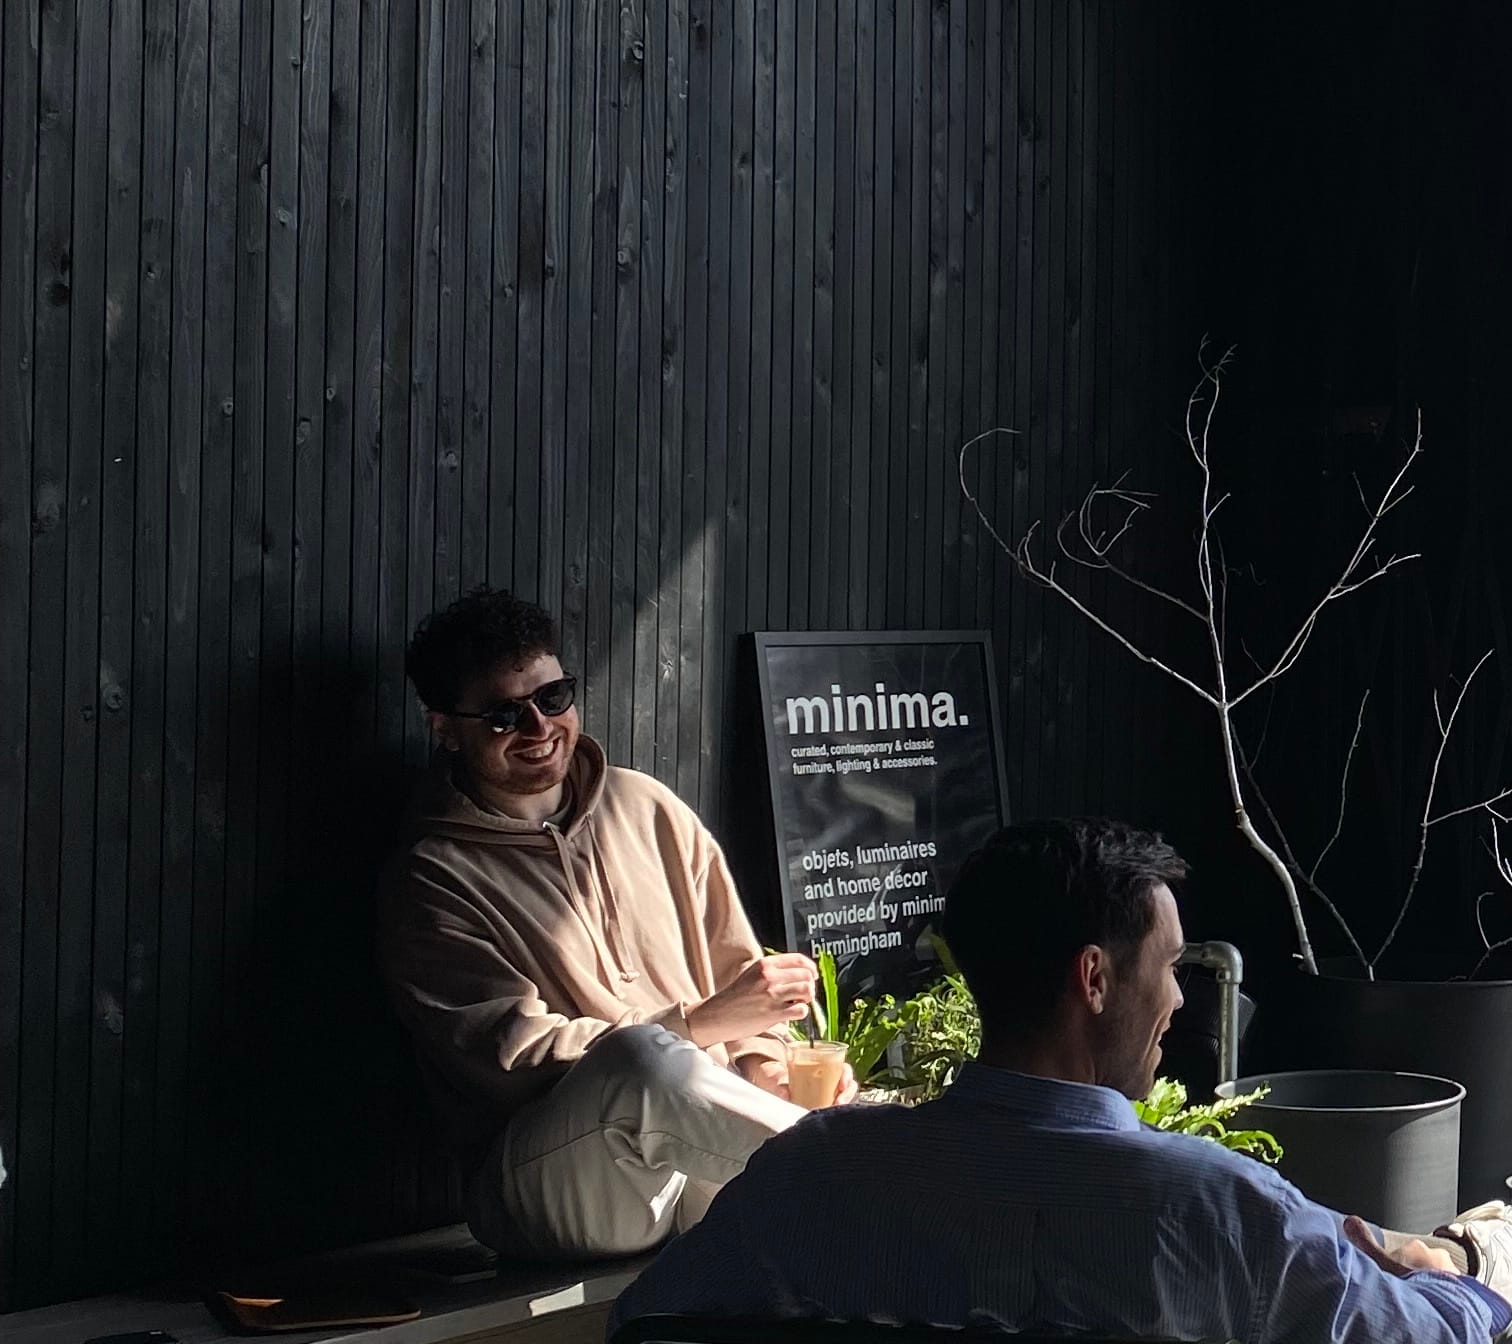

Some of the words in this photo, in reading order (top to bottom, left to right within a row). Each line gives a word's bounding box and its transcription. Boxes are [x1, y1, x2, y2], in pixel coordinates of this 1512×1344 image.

[786, 682, 969, 735] minima.
[791, 744, 830, 757] curated,
[830, 741, 893, 755] contemporary
[894, 739, 902, 751] &
[903, 737, 935, 751] classic
[792, 761, 836, 775] furniture,
[836, 758, 872, 774] lighting
[872, 757, 881, 769] &
[882, 754, 938, 769] accessories.
[802, 849, 855, 874] objets,
[856, 840, 937, 865] luminaires
[804, 878, 835, 900] and
[836, 876, 881, 896] home
[884, 868, 928, 891] décor
[807, 901, 876, 935] provided
[880, 900, 899, 923] by
[902, 894, 946, 916] minim
[811, 931, 902, 959] birmingham
